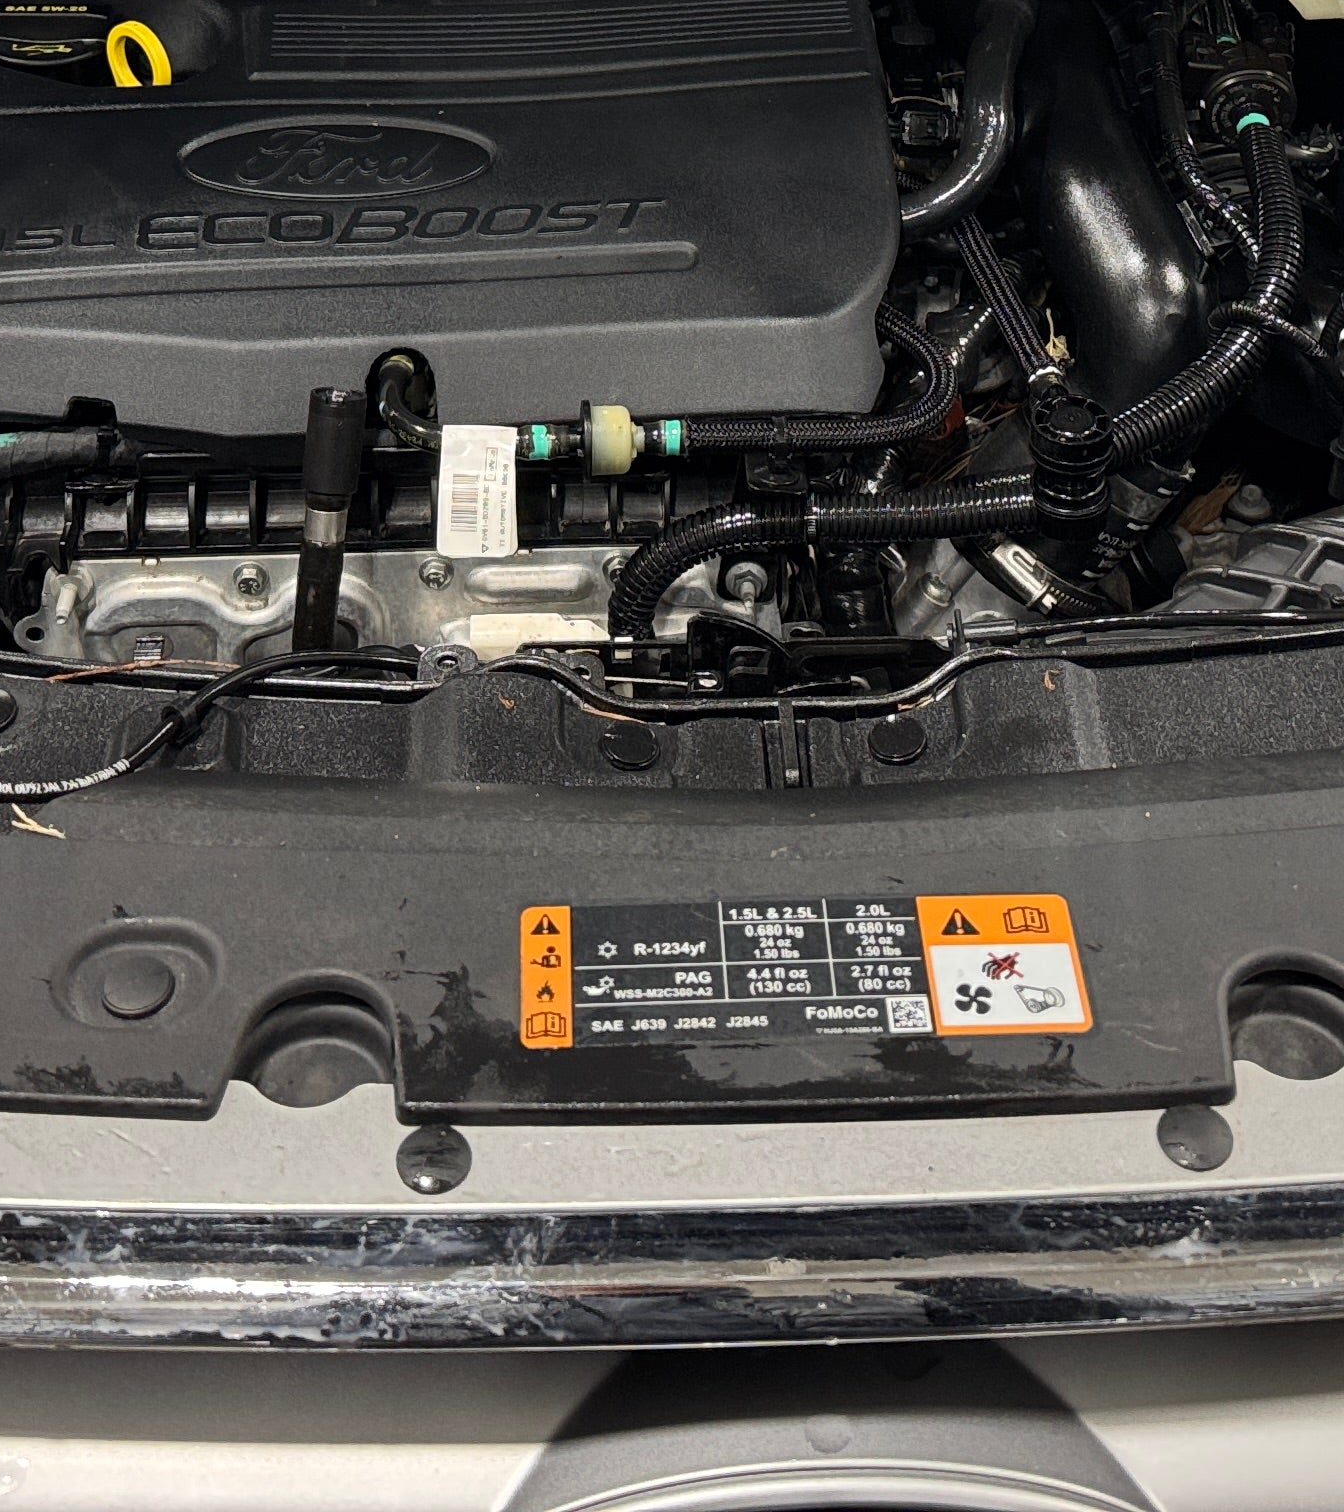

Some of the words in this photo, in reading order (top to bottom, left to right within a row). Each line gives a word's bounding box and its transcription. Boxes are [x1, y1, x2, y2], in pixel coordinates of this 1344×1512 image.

[235, 128, 441, 187] Ford
[728, 907, 763, 920] 1.5L
[766, 906, 779, 919] &
[782, 906, 817, 919] 2.5L
[856, 904, 891, 917] 2.0L
[744, 924, 783, 937] 0.680
[786, 923, 805, 939] kg
[845, 921, 884, 935] 0.680
[886, 921, 905, 937] kg
[759, 938, 775, 948] 24
[776, 939, 792, 947] oz
[861, 935, 876, 946] 24
[878, 936, 894, 945] oz
[633, 941, 707, 957] R-1234yf
[753, 949, 779, 959] 1.50
[781, 948, 800, 959] lbs
[856, 946, 881, 957] 1.50
[882, 945, 902, 956] lbs
[674, 970, 713, 985] PAG
[747, 967, 772, 979] 4.4
[774, 966, 786, 979] fl
[788, 968, 809, 979] oz
[850, 965, 874, 977] 2.7
[877, 964, 889, 977] fl
[892, 965, 912, 976] oz
[749, 980, 783, 996] (130
[786, 979, 812, 994] cc)
[858, 978, 883, 992] (80
[886, 977, 911, 992] cc)
[805, 1005, 879, 1020] FoMoCo
[591, 1019, 625, 1033] SAE
[630, 1018, 668, 1031] J639
[674, 1016, 717, 1030] J2842
[725, 1015, 769, 1029] J2845
